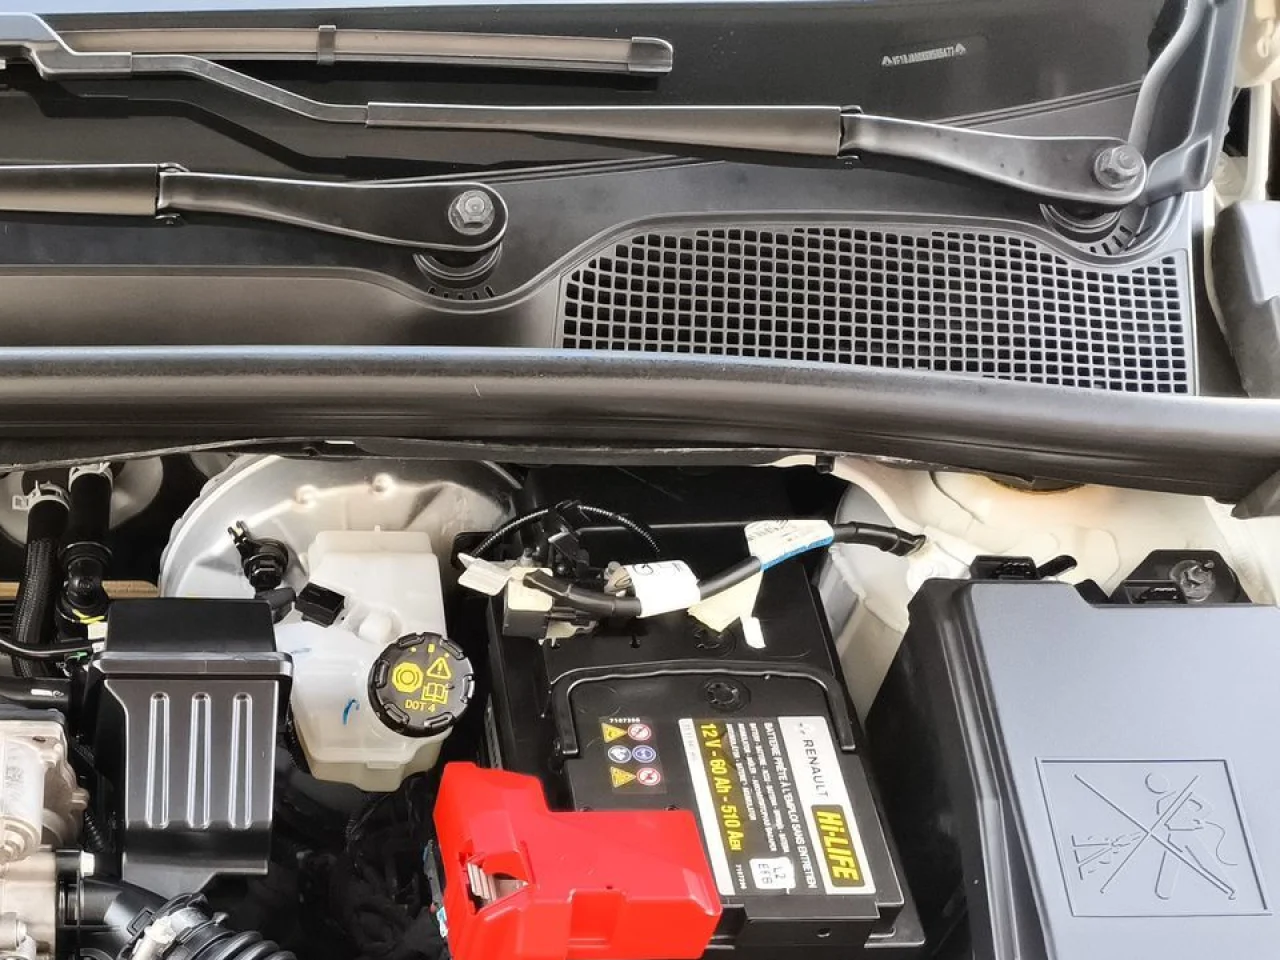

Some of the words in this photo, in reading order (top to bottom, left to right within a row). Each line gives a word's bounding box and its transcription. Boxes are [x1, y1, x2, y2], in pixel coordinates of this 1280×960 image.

[405, 699, 426, 711] DOT
[428, 703, 436, 712] 4
[708, 758, 728, 774] 60
[801, 739, 829, 797] RENAULT
[712, 776, 733, 793] Ah
[719, 804, 742, 827] 510
[815, 810, 859, 881] Hi-LIFE
